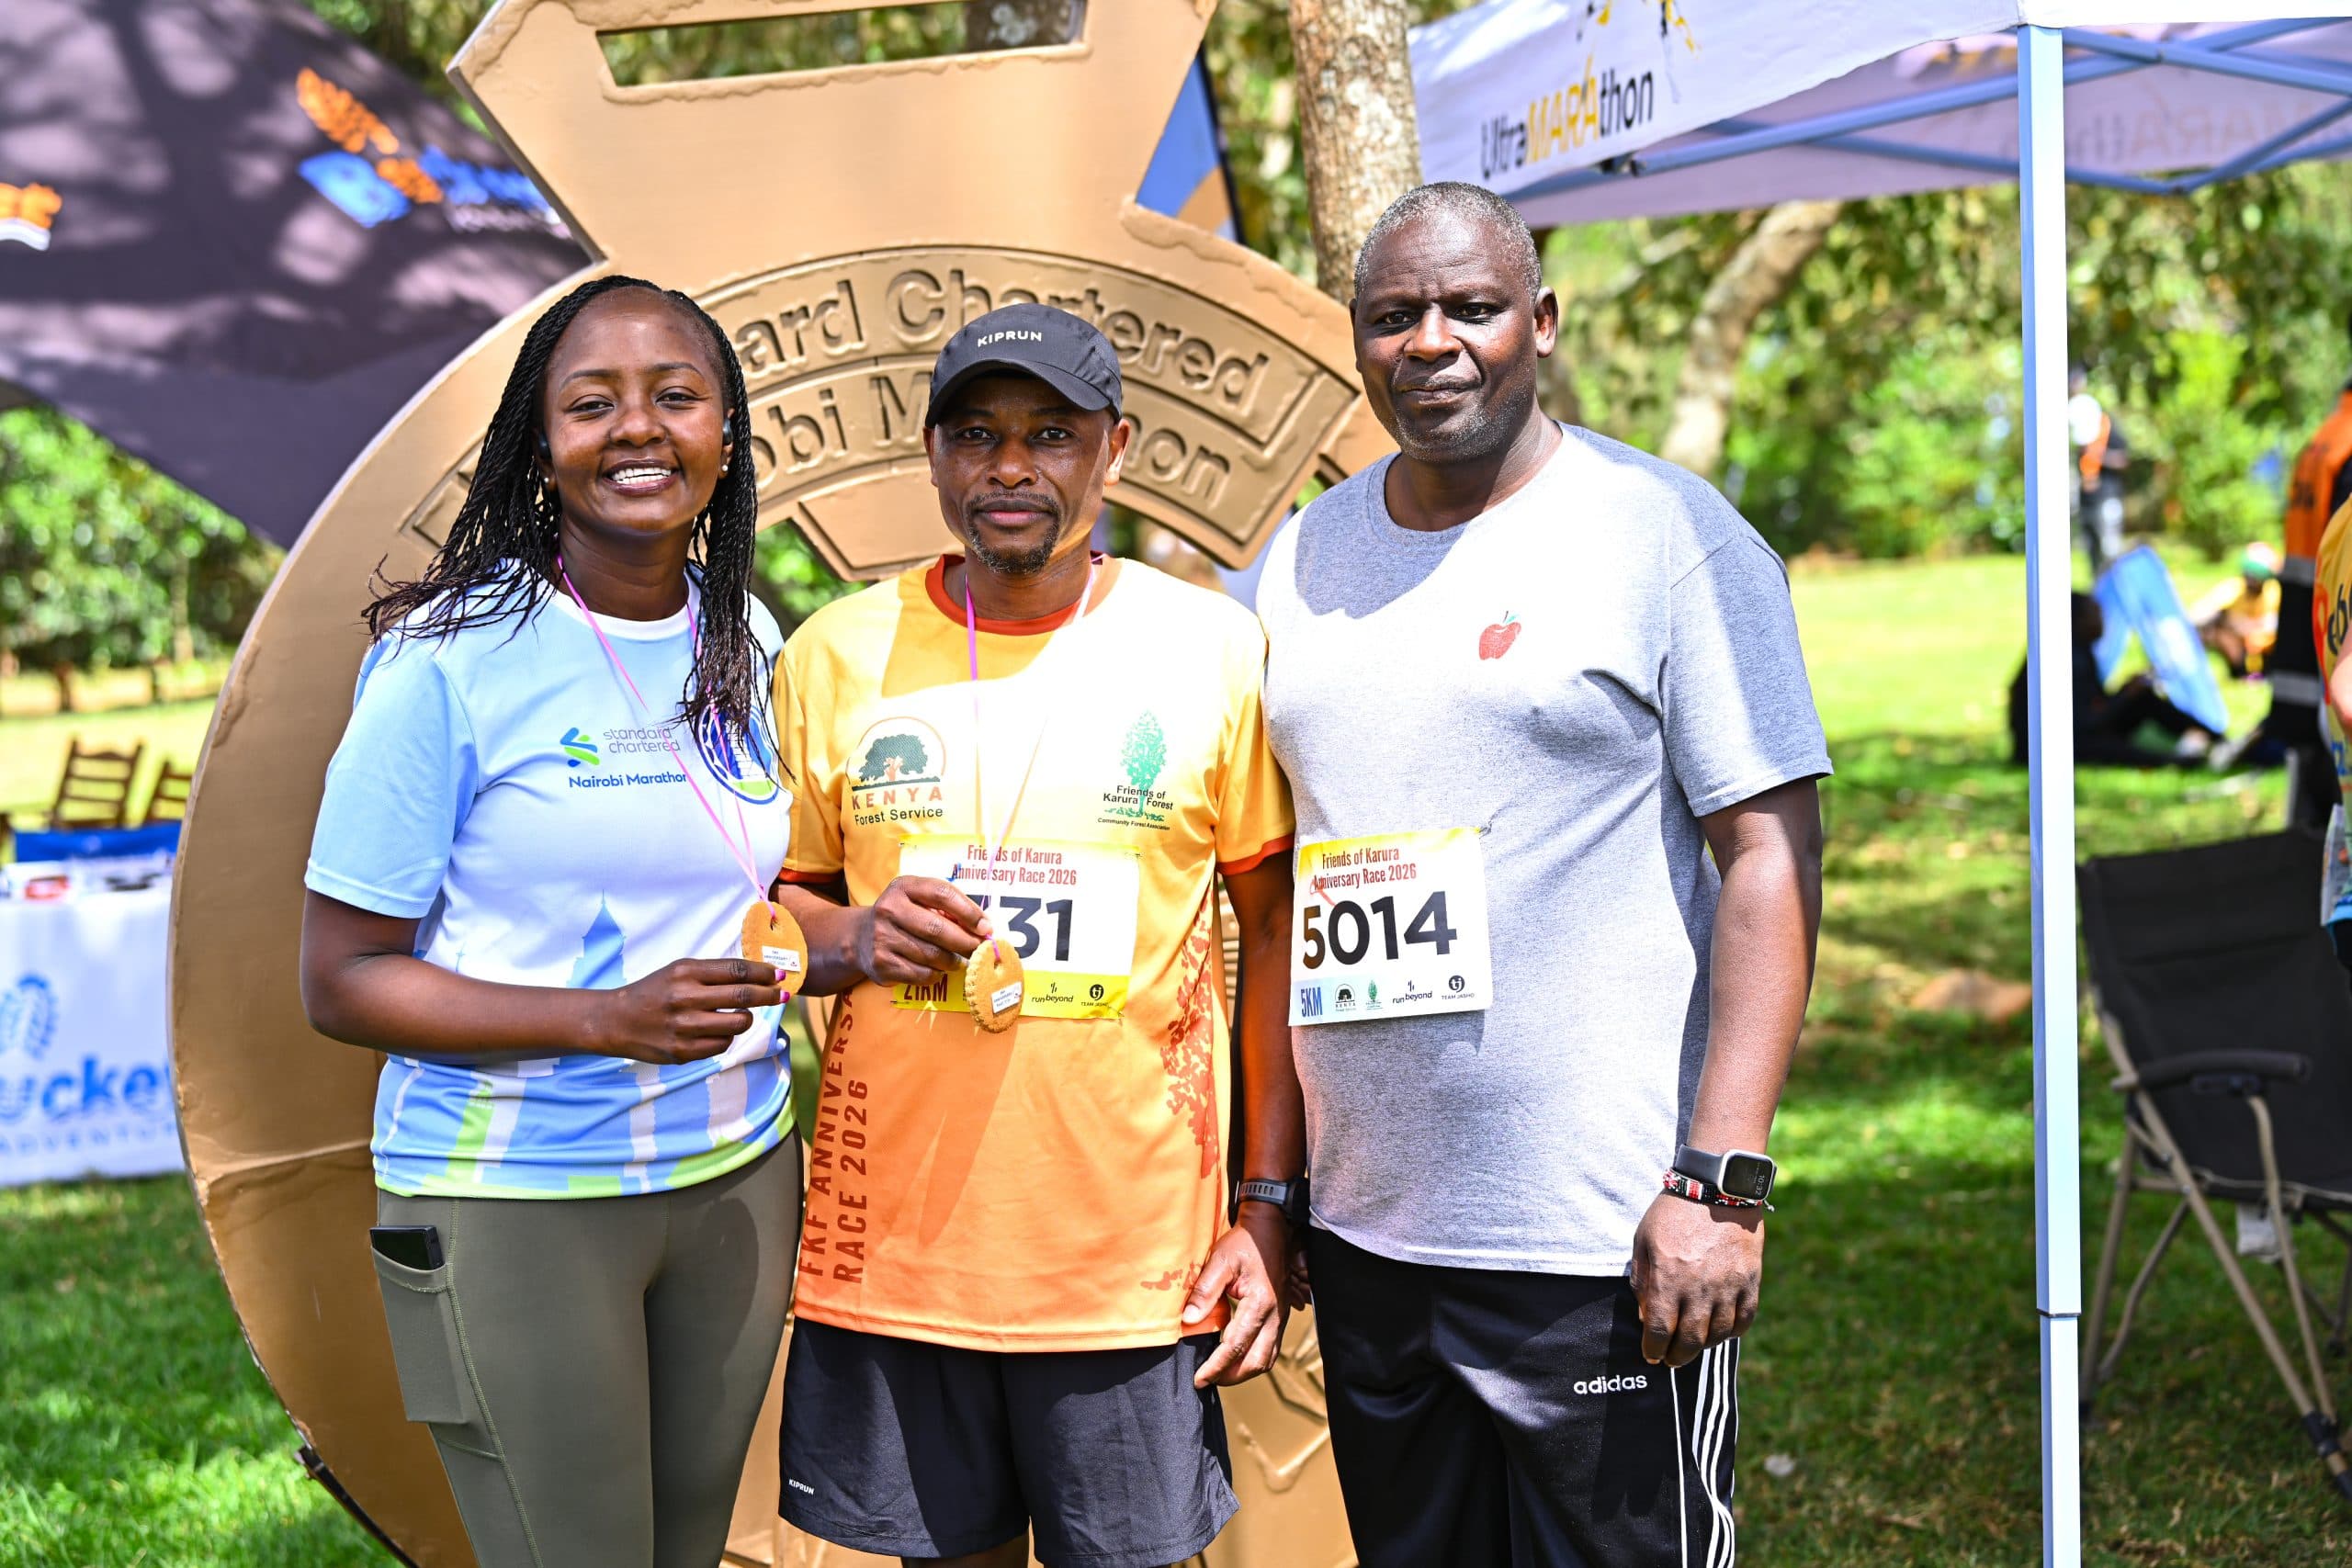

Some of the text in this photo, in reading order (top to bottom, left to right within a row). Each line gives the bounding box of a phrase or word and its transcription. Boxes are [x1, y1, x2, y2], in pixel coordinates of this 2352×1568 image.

[1482, 66, 1653, 180] UltraMARAthon
[886, 268, 1272, 421] Chtered
[978, 331, 1042, 347] KIPRUN
[603, 728, 673, 740] standard
[608, 739, 681, 753] chartered
[569, 773, 624, 788] Nairobi
[851, 786, 943, 810] KENYA
[1103, 793, 1173, 810] Karura Forest
[1116, 785, 1167, 800] Friends of
[854, 807, 943, 826] Forest Service
[1097, 818, 1130, 826] Community
[967, 845, 1062, 864] Frieds of Karura
[1322, 848, 1399, 870] Friends of Karura
[1019, 867, 1046, 884] Race
[1048, 869, 1077, 885] 2026
[1314, 863, 1417, 890] Anniversary Race 2026
[1303, 890, 1457, 970] 5014
[1046, 994, 1073, 1003] beyond
[1301, 987, 1323, 1018] 5KM
[1405, 991, 1432, 1001] beyond
[832, 1079, 868, 1284] RACE 2026
[798, 1209, 829, 1276] FKF
[1574, 1374, 1648, 1394] adidas
[788, 1478, 815, 1495] KIPRUN
